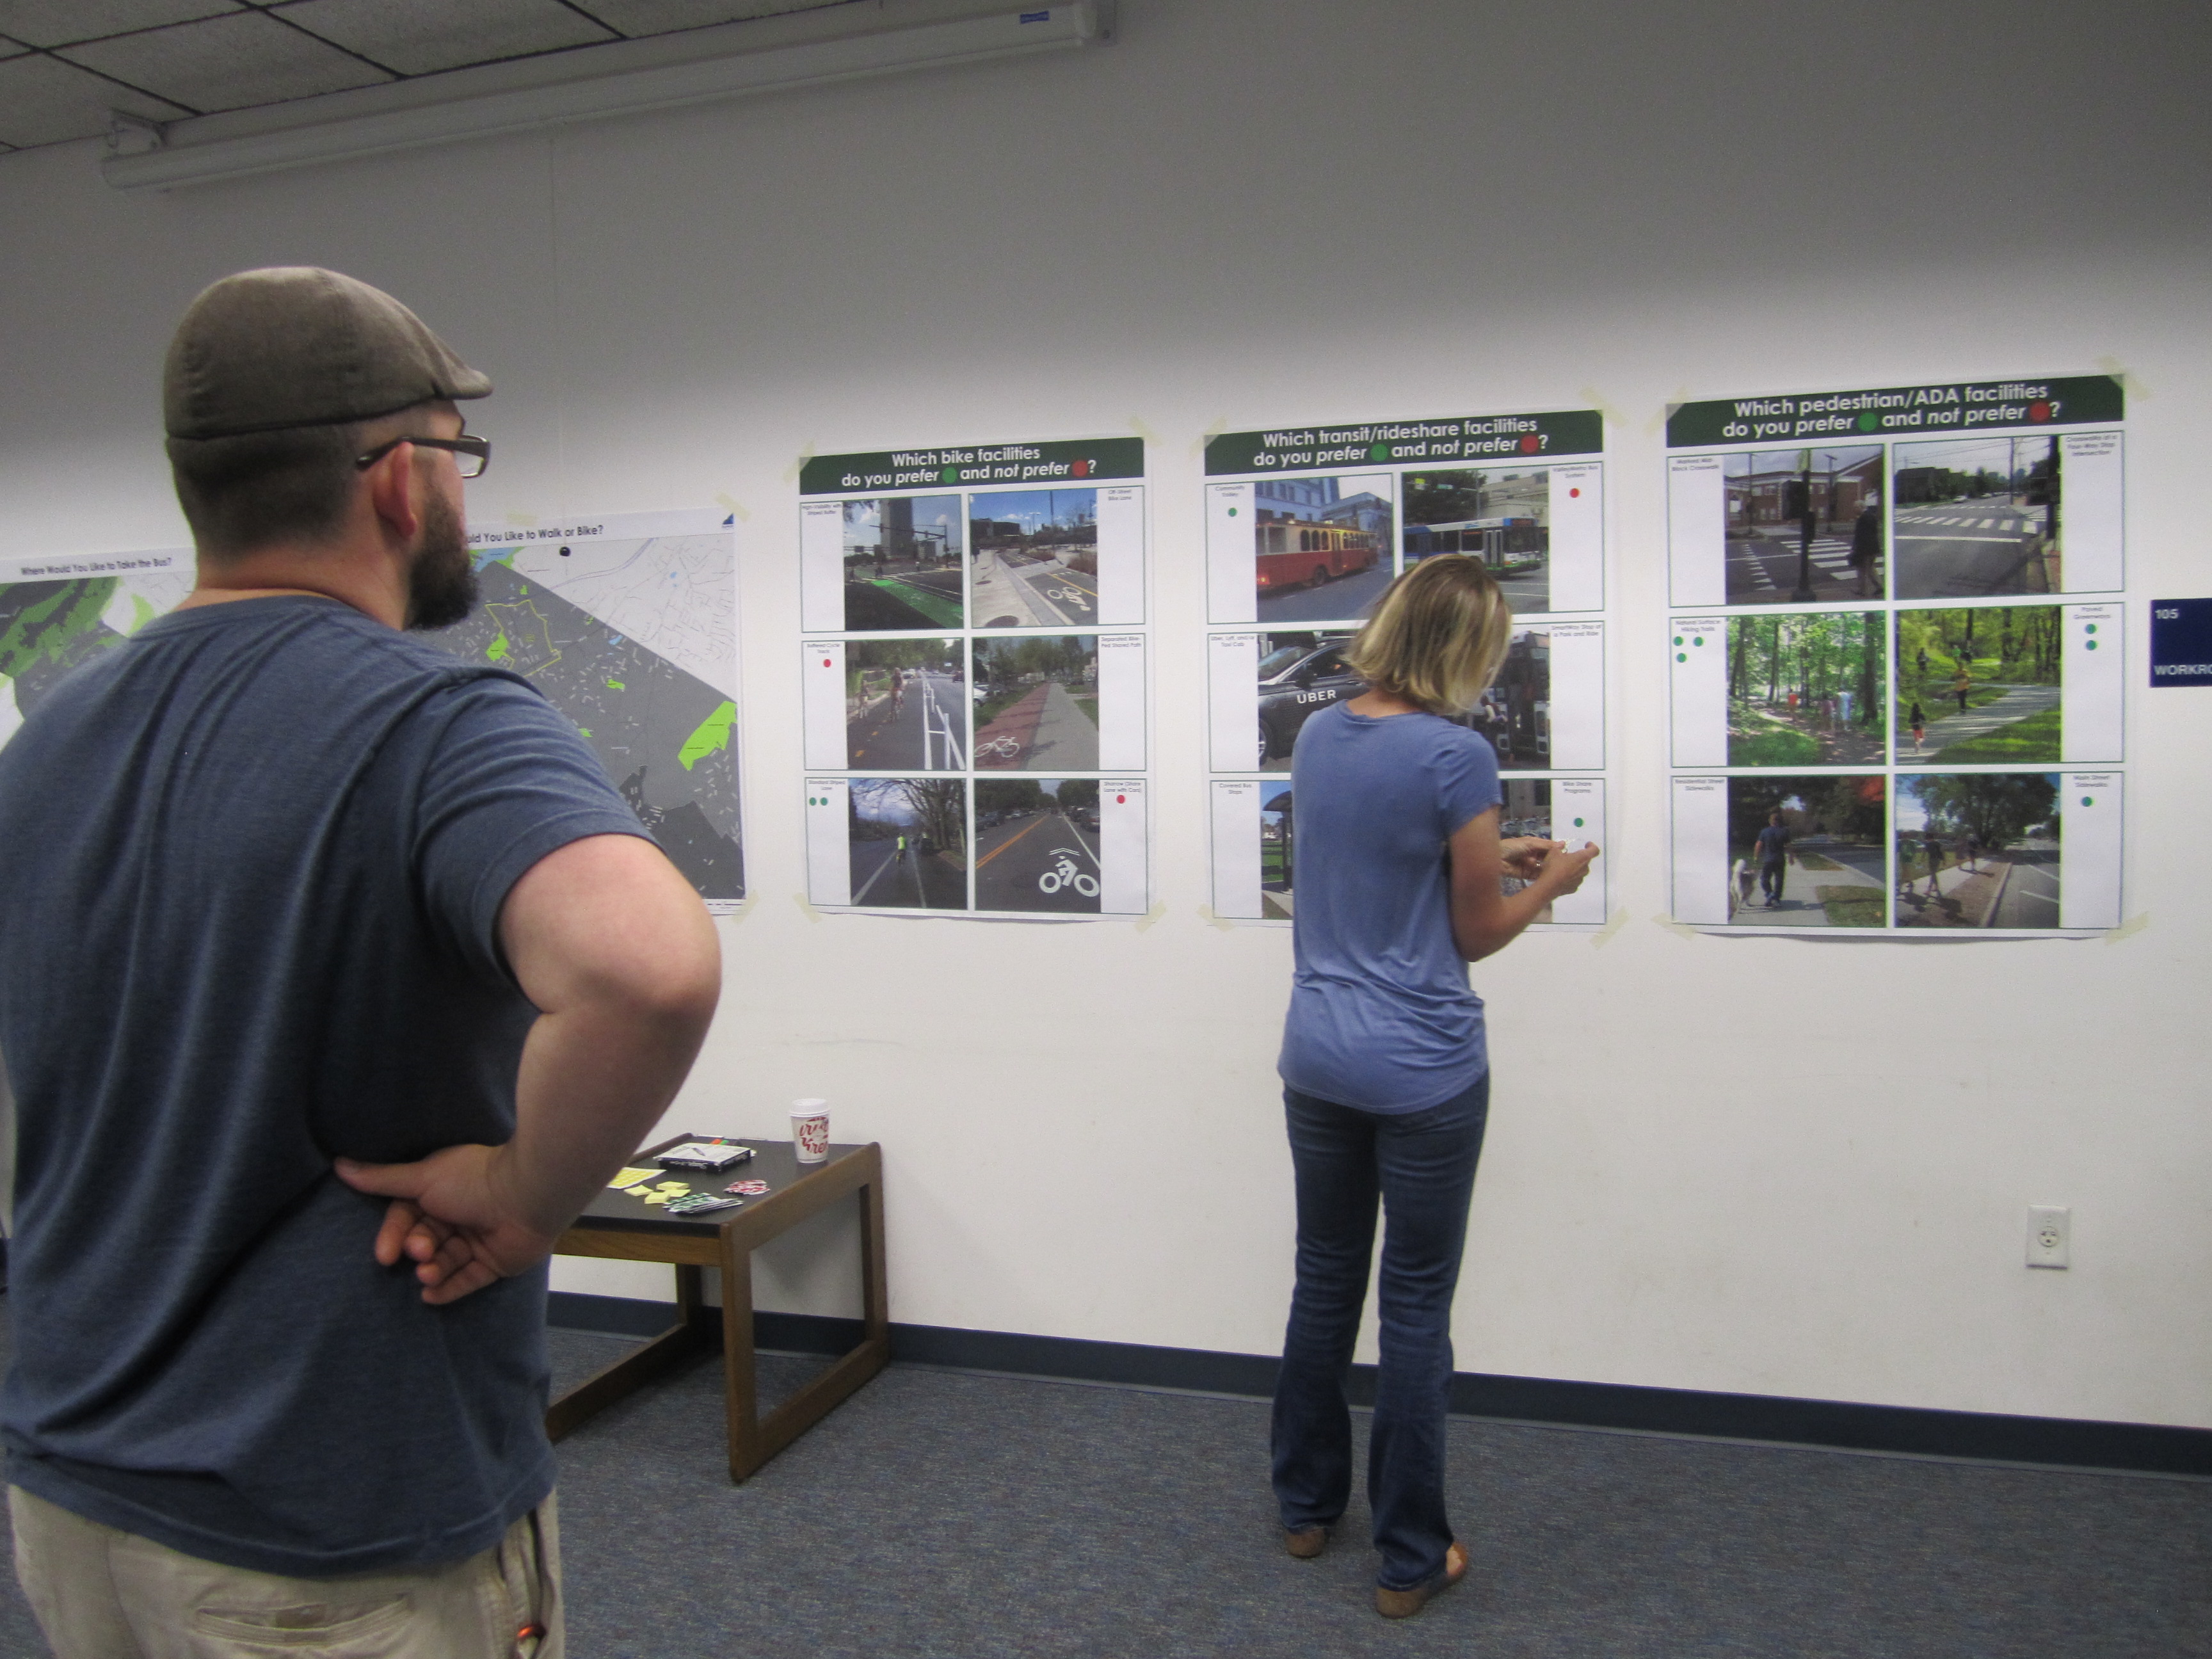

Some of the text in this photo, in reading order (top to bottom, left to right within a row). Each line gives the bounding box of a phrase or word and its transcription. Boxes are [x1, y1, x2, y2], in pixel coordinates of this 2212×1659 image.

[1734, 383, 2048, 418] Which pedestrian/ADA facilities
[1263, 418, 1537, 448] Which transit/rideshare facilities
[1722, 401, 2061, 440] do you prefer and not prefer ?
[892, 447, 1041, 467] Which bike facilities
[1254, 435, 1549, 468] do you prefer and not prefer ?
[842, 460, 1097, 488] do you prefer and not prefer ?
[468, 525, 604, 543] uld You Like to Walk or Bike?
[2155, 609, 2179, 620] 105
[1297, 689, 1336, 704] UBER
